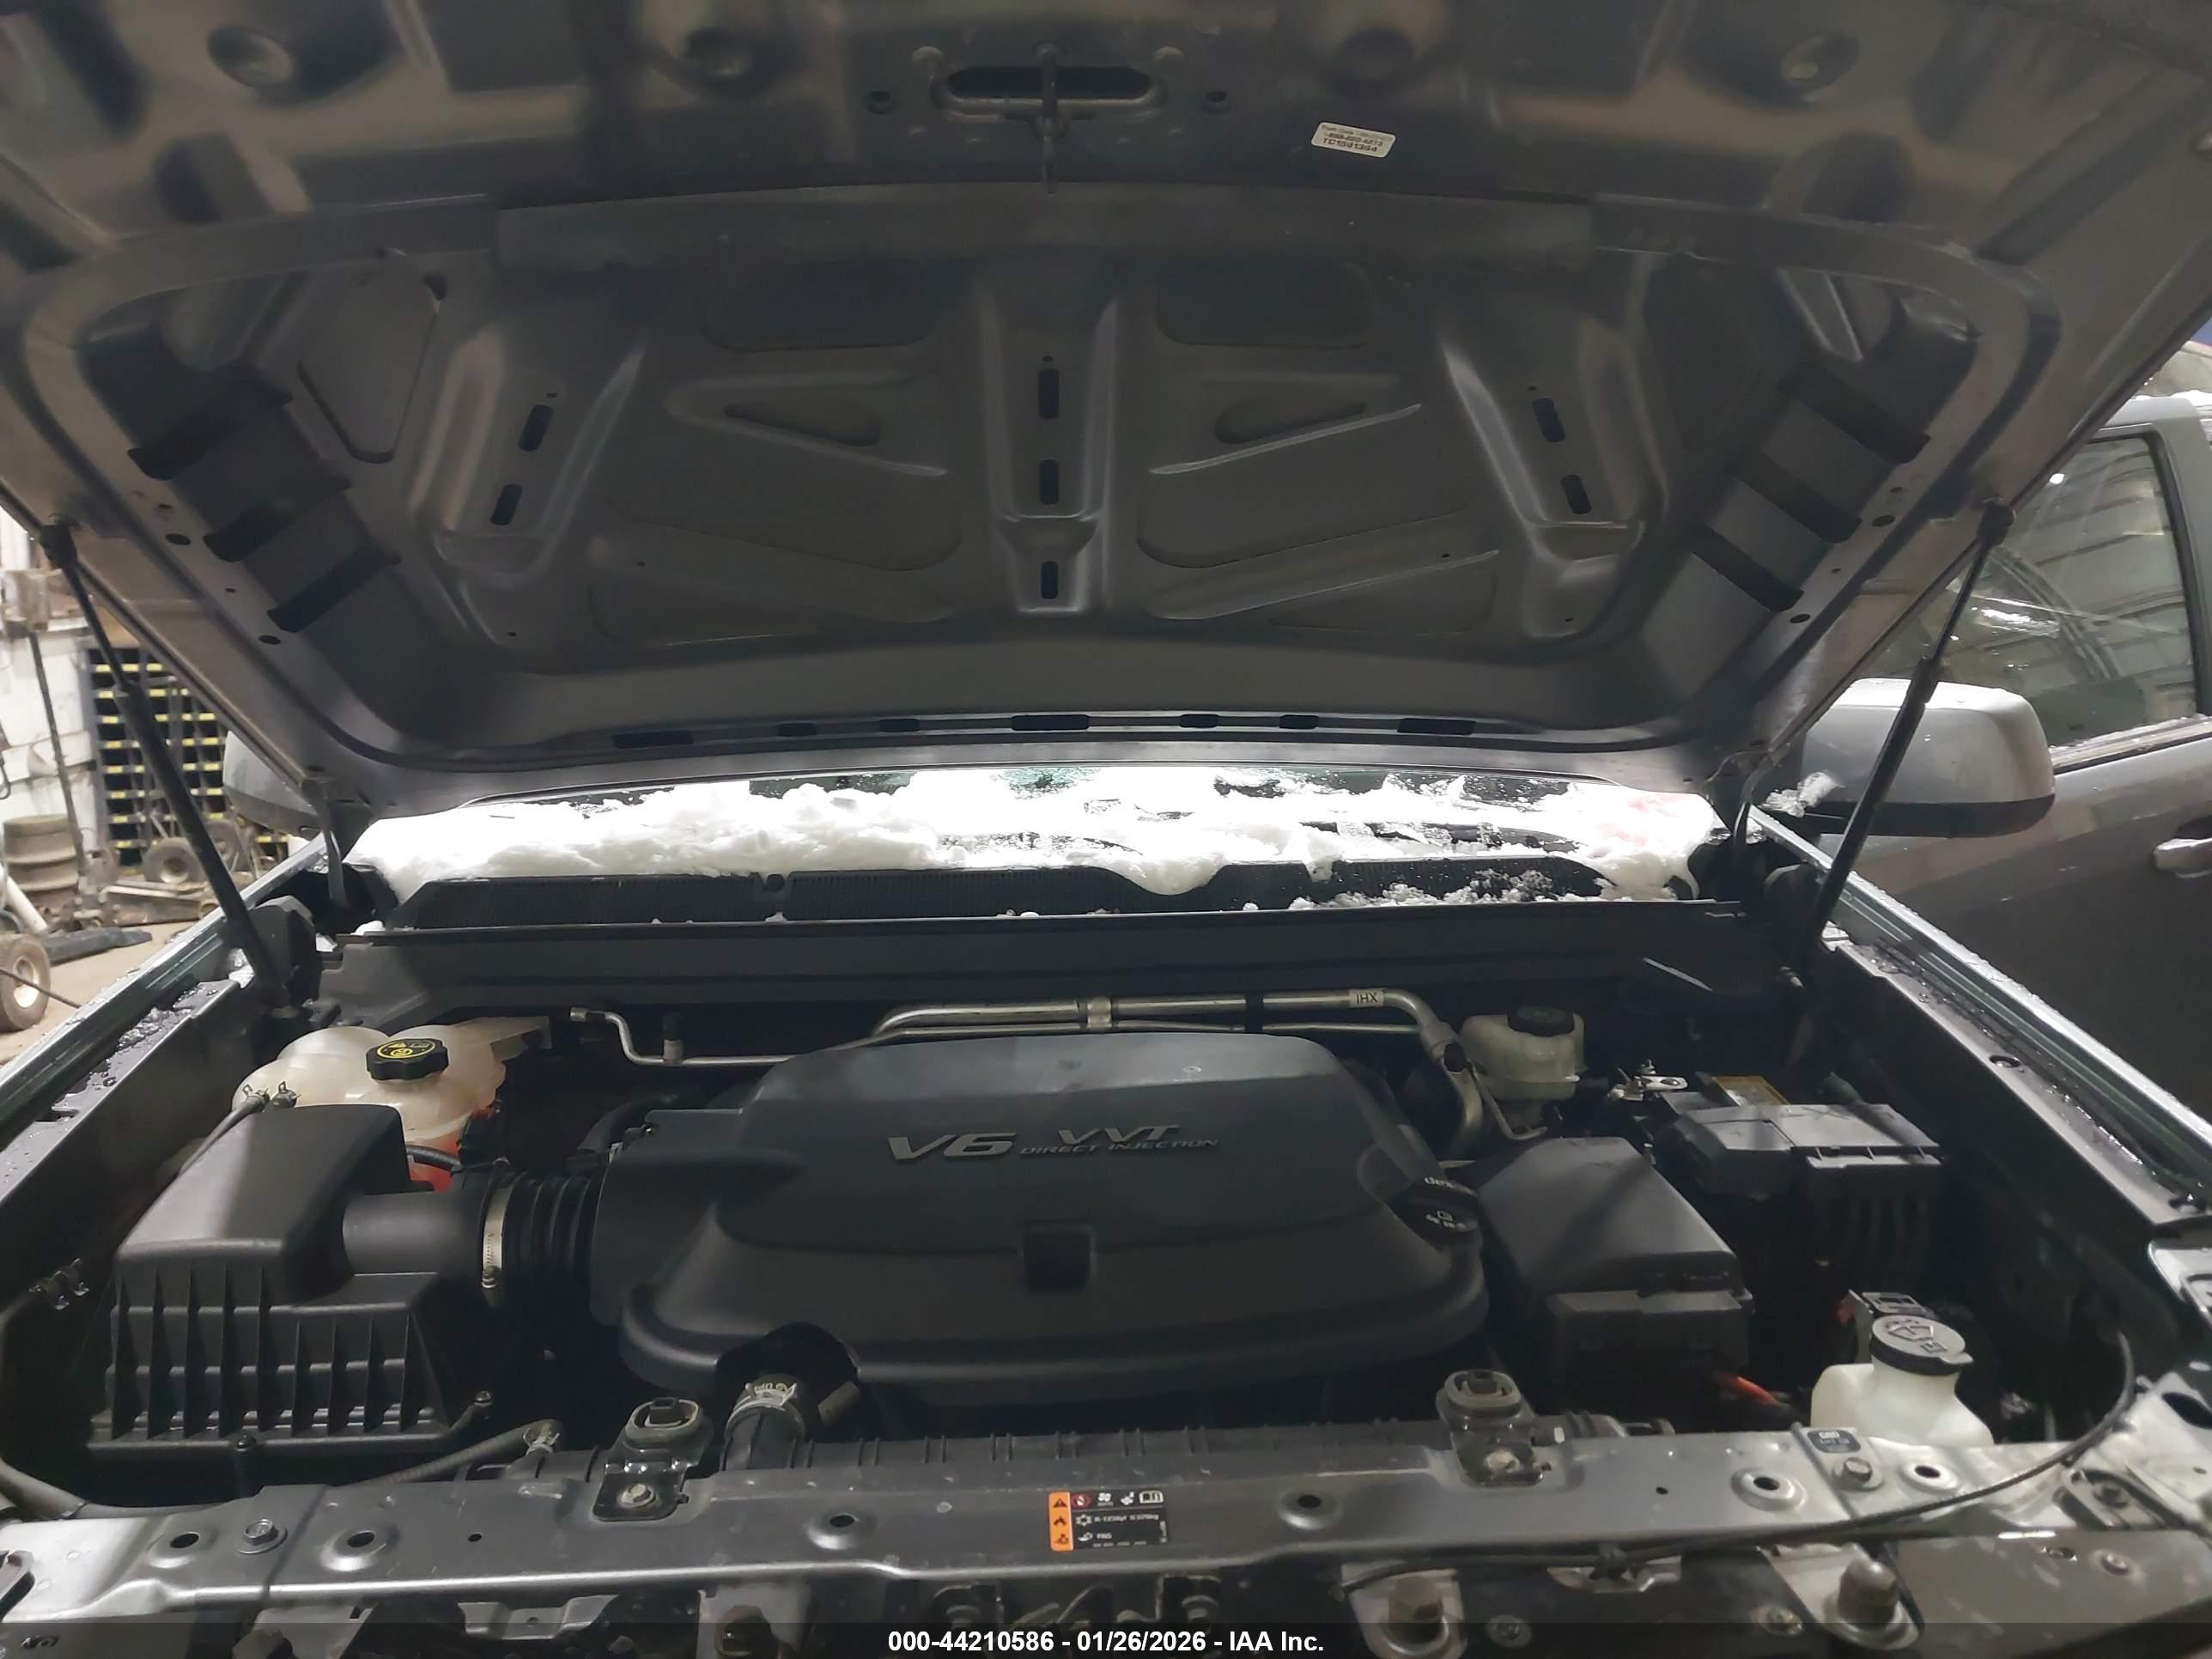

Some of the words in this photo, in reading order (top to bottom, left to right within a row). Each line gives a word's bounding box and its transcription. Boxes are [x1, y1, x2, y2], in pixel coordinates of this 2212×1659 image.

[1356, 992, 1378, 1004] IHX
[1058, 1124, 1181, 1145] VVT
[888, 1132, 1018, 1160] V6
[1019, 1144, 1100, 1156] DIRECT
[1108, 1139, 1219, 1151] INJECTION
